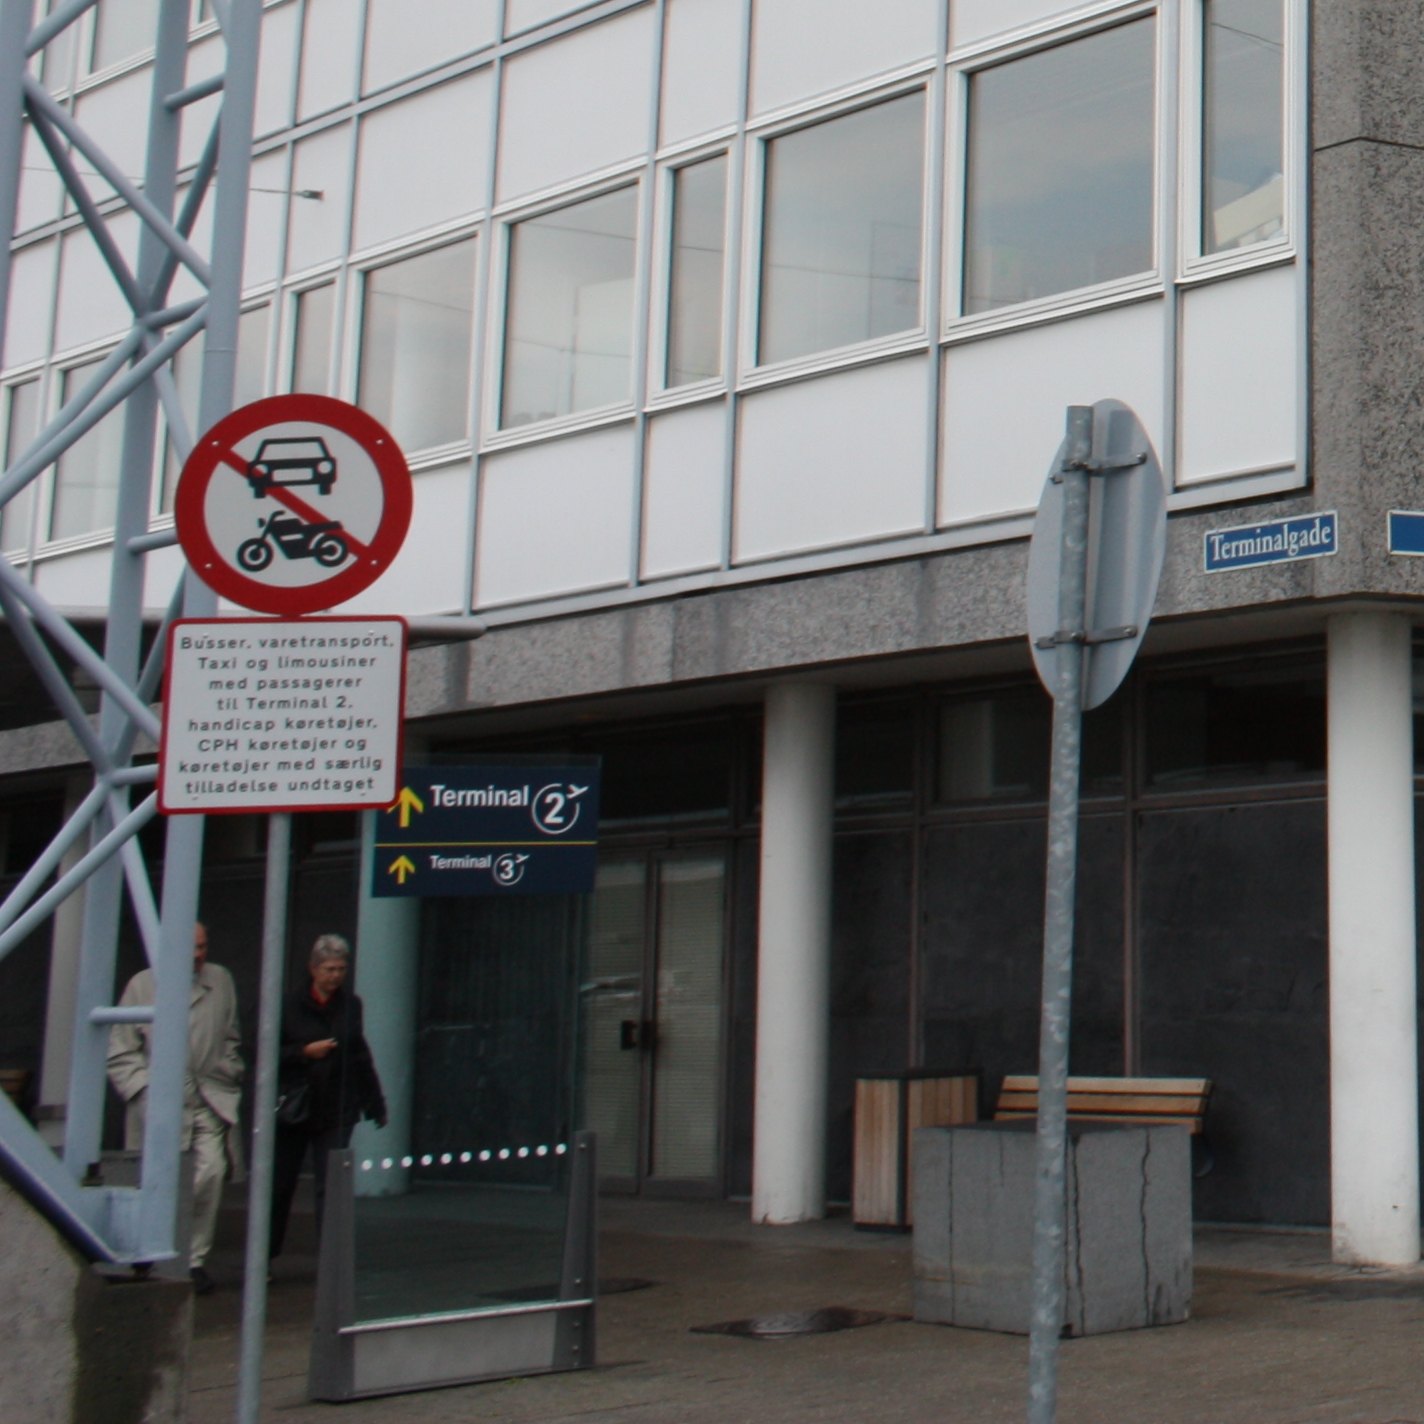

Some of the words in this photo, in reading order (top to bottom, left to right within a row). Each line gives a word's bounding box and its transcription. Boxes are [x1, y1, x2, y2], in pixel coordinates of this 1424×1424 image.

[1210, 518, 1332, 561] Terminalgade
[198, 656, 237, 670] Taxi
[246, 658, 269, 672] og
[278, 655, 377, 669] limousiner
[209, 677, 248, 690] med
[257, 677, 363, 691] passagerer
[217, 697, 238, 711] til
[247, 696, 328, 710] Terminal
[188, 718, 276, 732] handicap
[198, 739, 239, 752] CPH
[248, 738, 338, 752] køretøjer
[345, 738, 368, 751] og
[179, 759, 270, 774] køretøjer
[277, 758, 316, 771] med
[325, 756, 383, 771] særlig
[185, 779, 279, 794] tilladelse
[287, 777, 376, 793] undtaget
[429, 784, 530, 807] Terminal
[543, 792, 566, 824] 2
[429, 854, 492, 869] Terminal
[499, 859, 515, 880] 3
